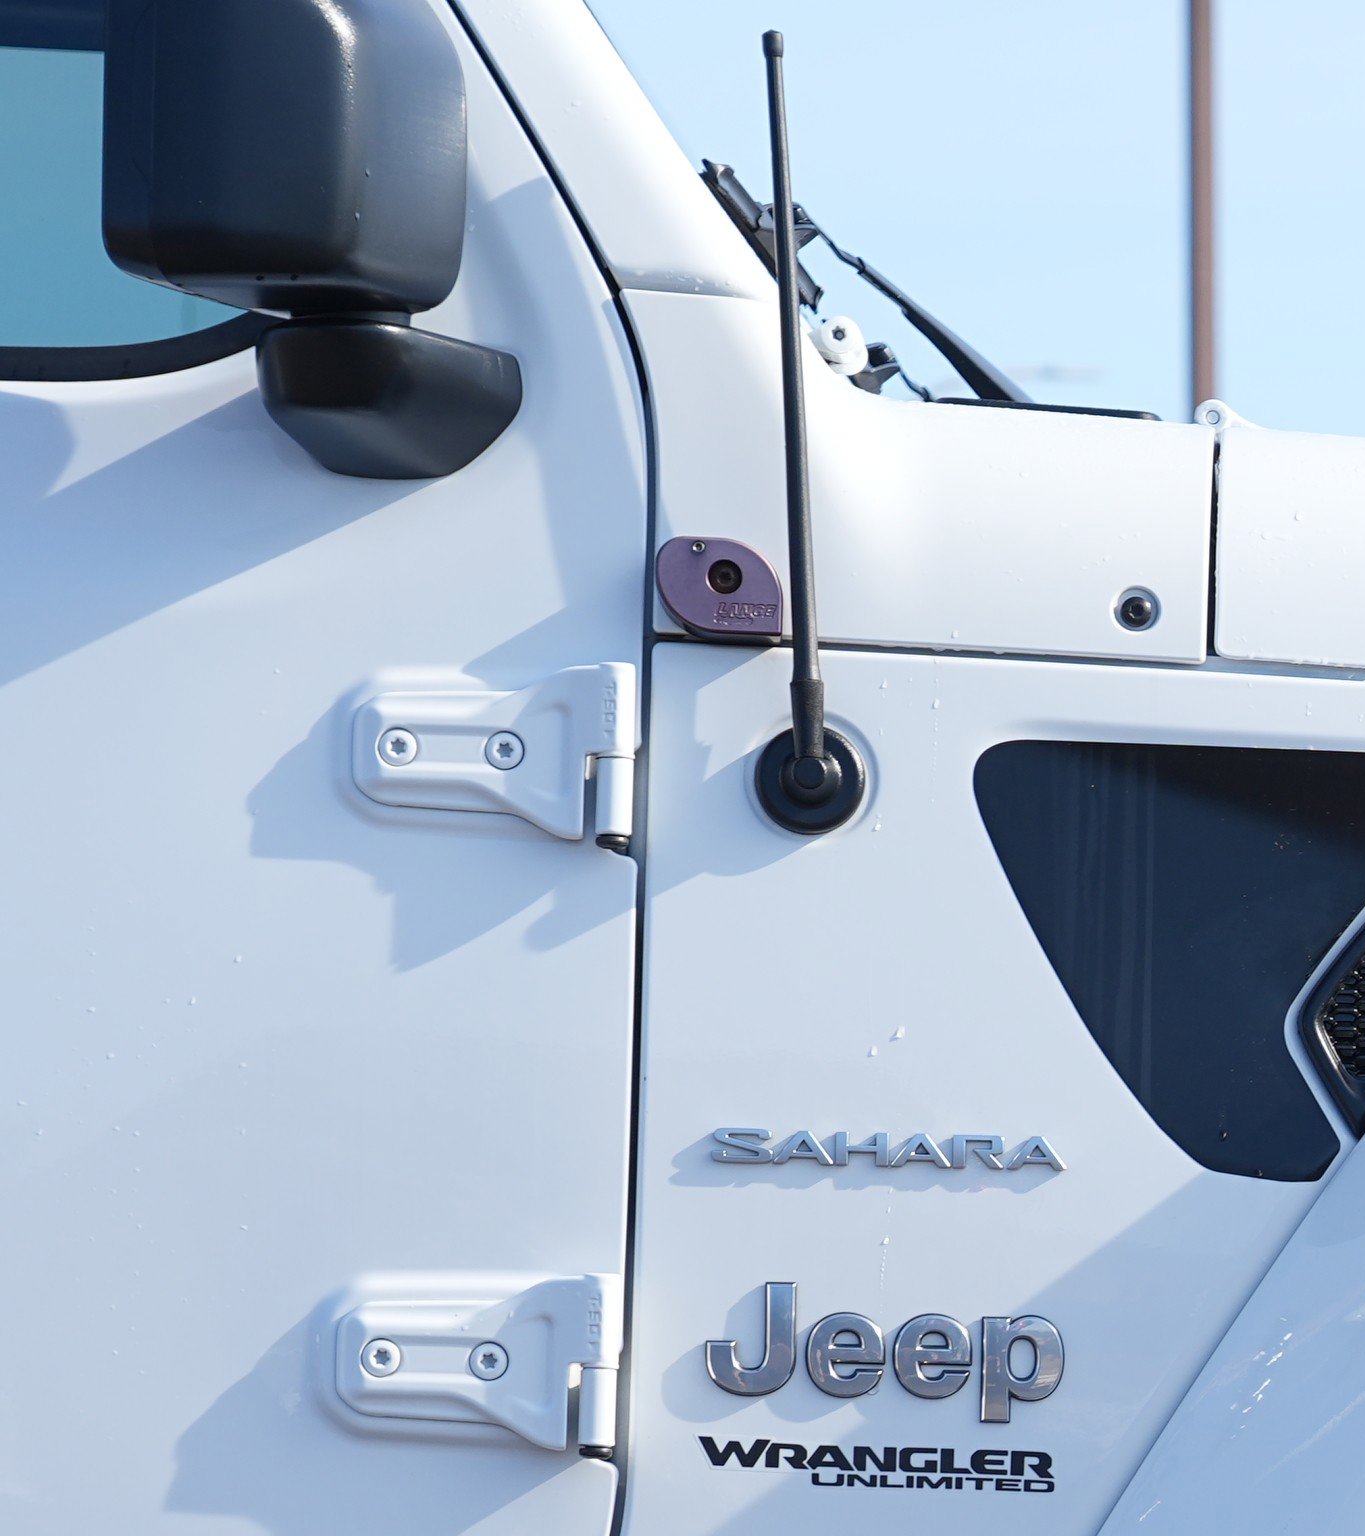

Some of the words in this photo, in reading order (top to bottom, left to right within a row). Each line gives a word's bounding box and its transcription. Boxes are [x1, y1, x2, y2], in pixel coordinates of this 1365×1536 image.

[711, 1127, 1067, 1171] SAHARA
[705, 1281, 1065, 1424] Jeep
[698, 1436, 1054, 1479] WRANGLER
[811, 1472, 1055, 1493] UNLIMITED
